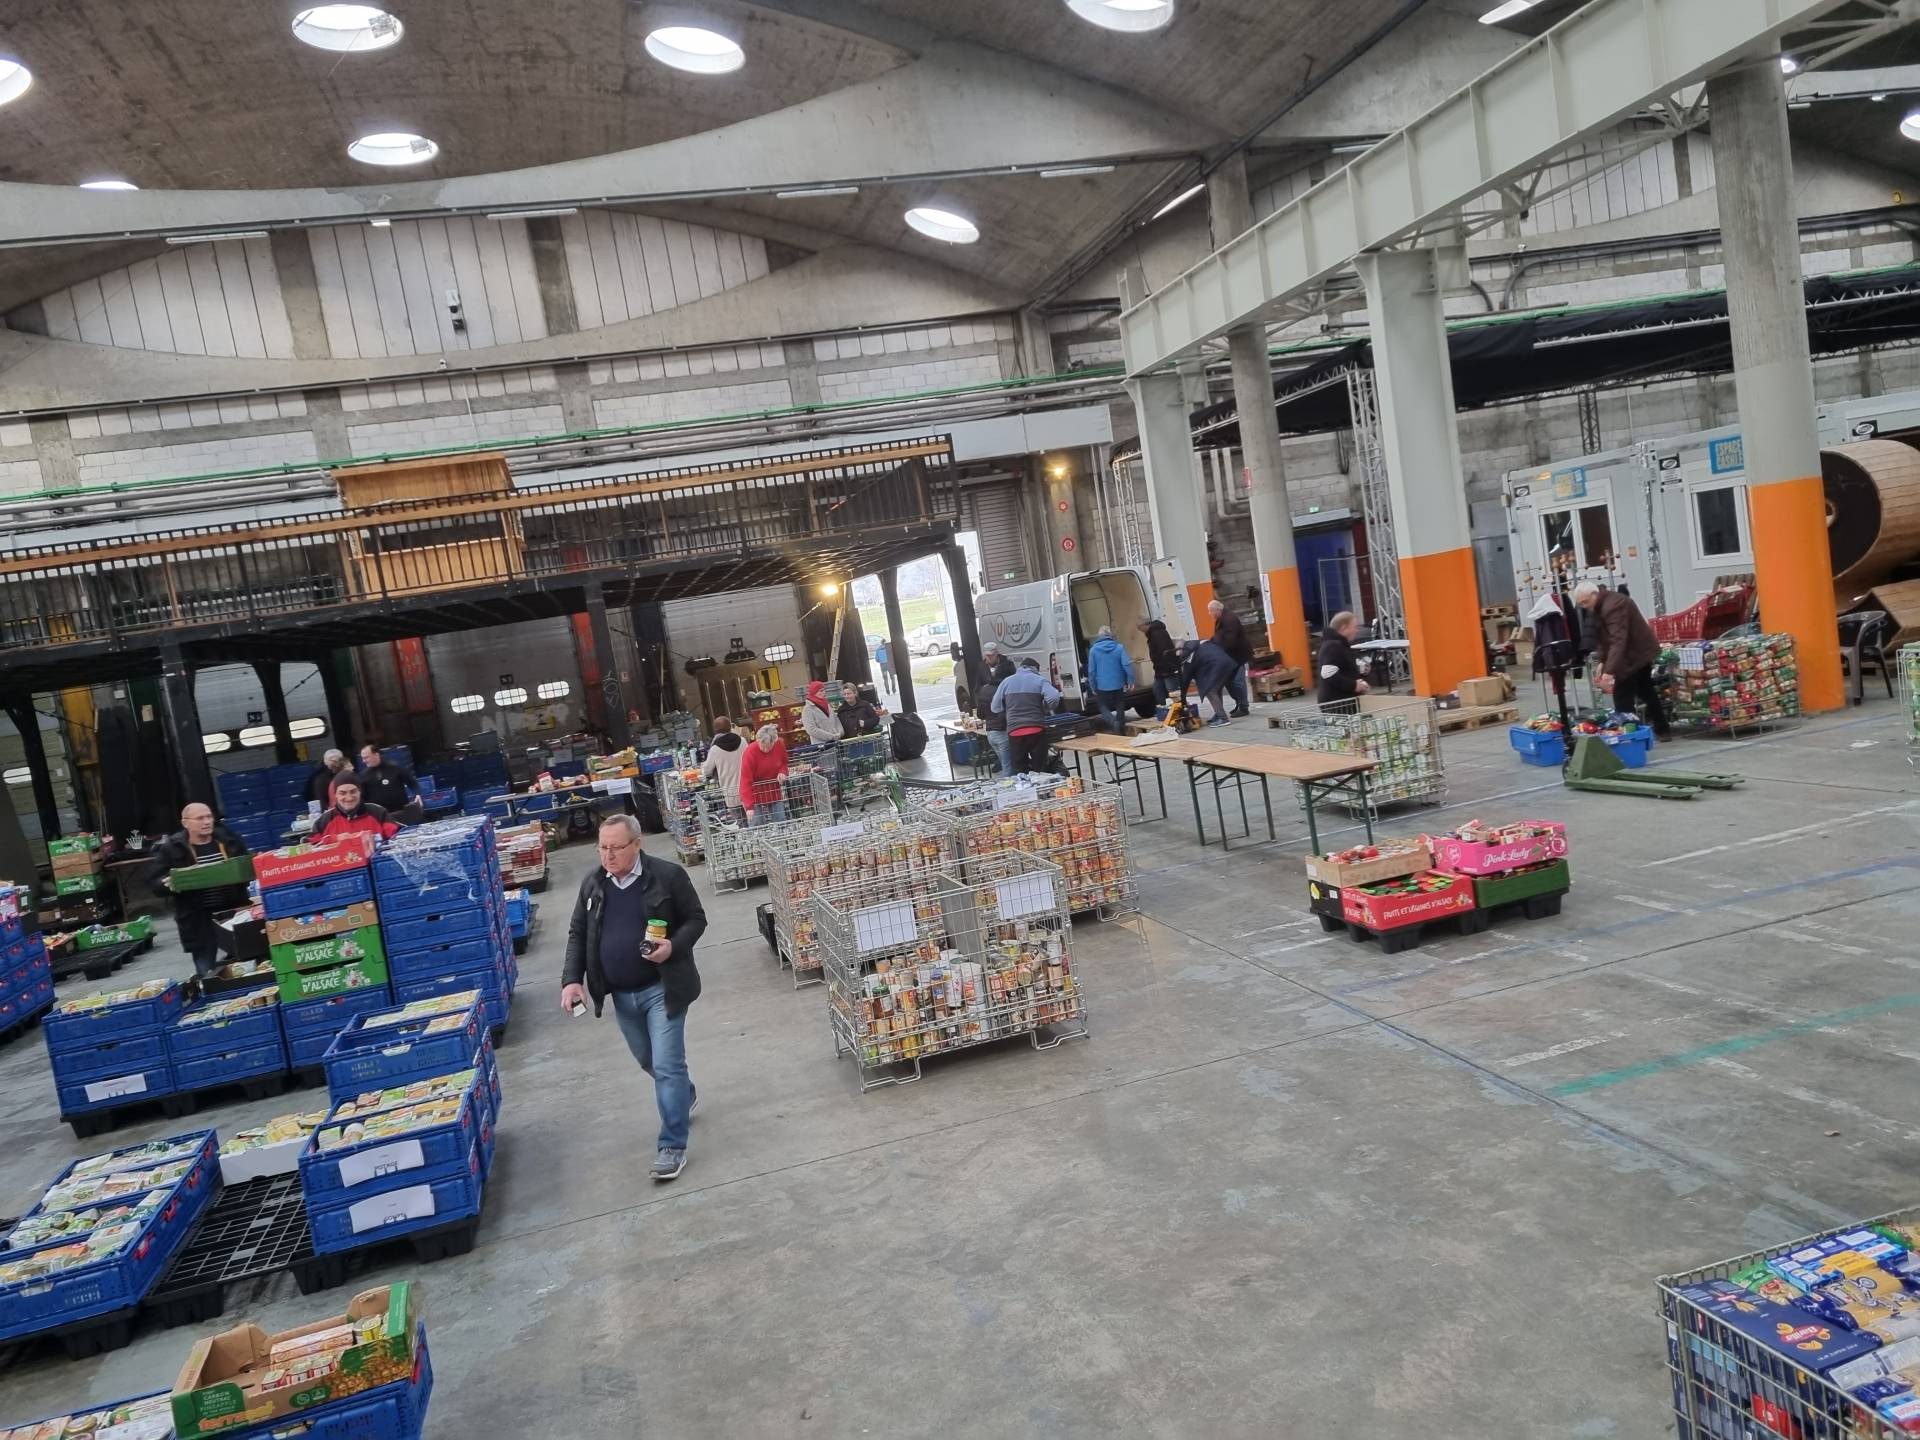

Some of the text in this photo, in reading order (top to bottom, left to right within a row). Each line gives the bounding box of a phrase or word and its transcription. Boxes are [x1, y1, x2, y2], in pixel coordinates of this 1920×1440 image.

[1005, 619, 1031, 636] location
[1482, 847, 1532, 868] Pink Lady
[261, 867, 280, 879] FRUITS
[281, 865, 290, 873] ET
[1383, 909, 1400, 920] FRUITS
[1400, 906, 1409, 915] ET
[296, 948, 334, 963] D'ALSACE
[302, 978, 341, 993] D'ALSACE
[1786, 1325, 1818, 1342] Barilla
